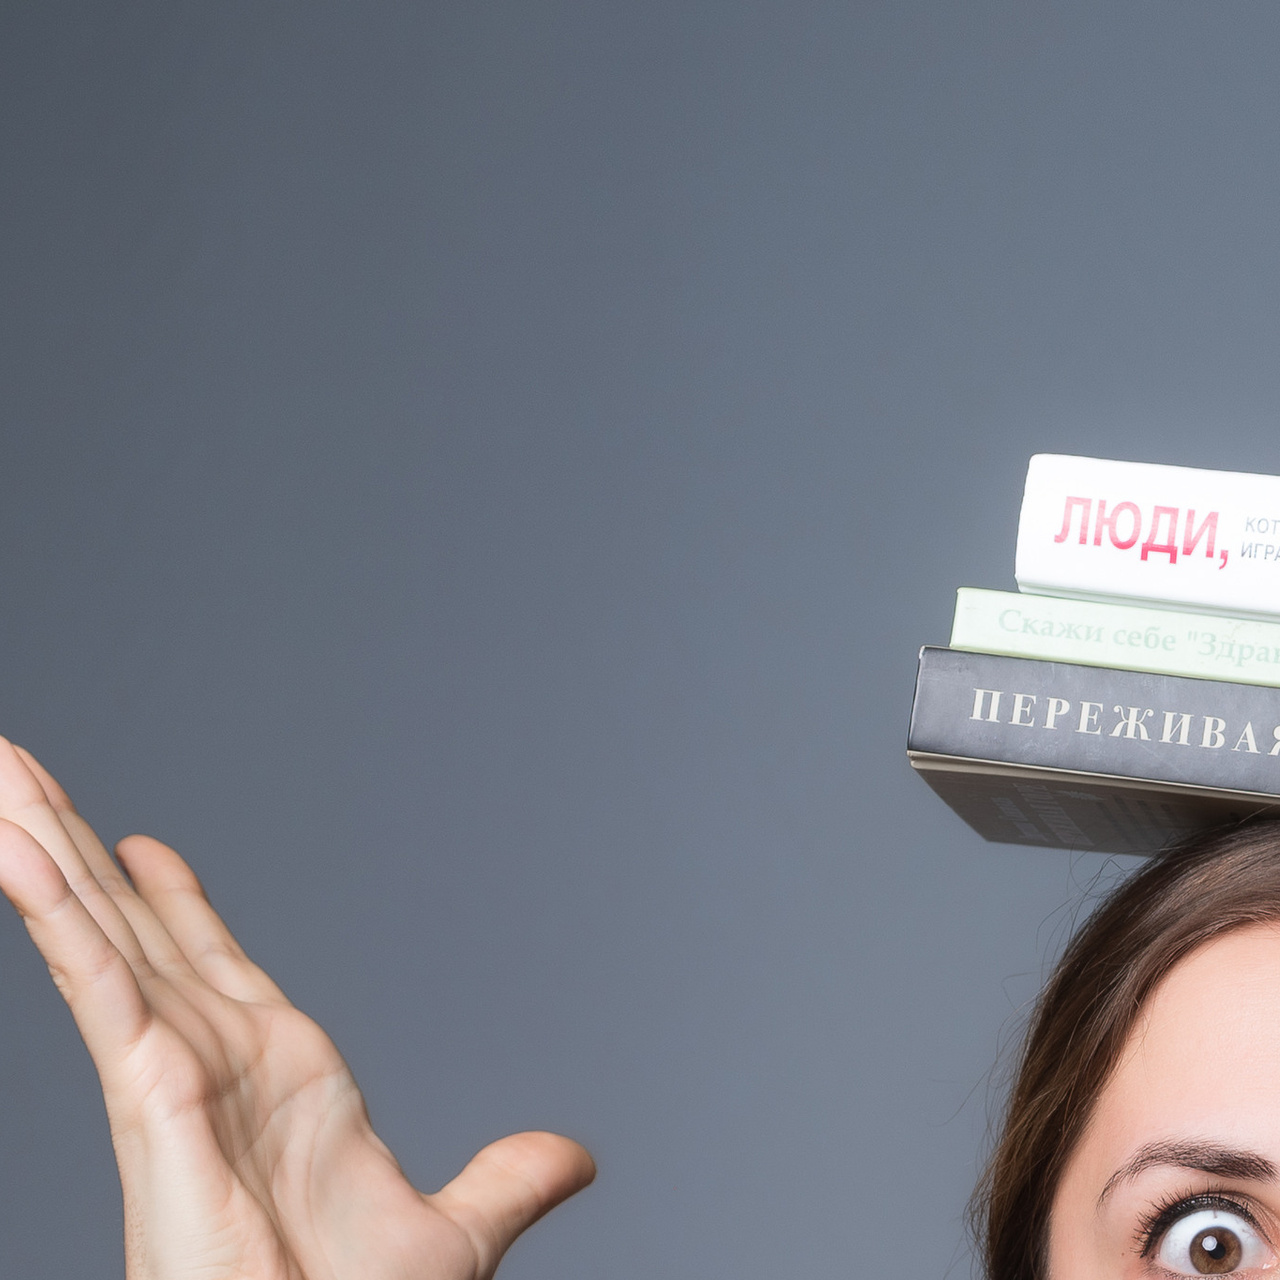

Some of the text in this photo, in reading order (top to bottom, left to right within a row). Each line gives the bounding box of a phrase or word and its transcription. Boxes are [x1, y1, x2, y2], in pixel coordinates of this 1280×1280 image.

[1054, 496, 1229, 570] ЛЮДИ,
[998, 608, 1104, 643] Скажи
[1112, 626, 1177, 652] себе
